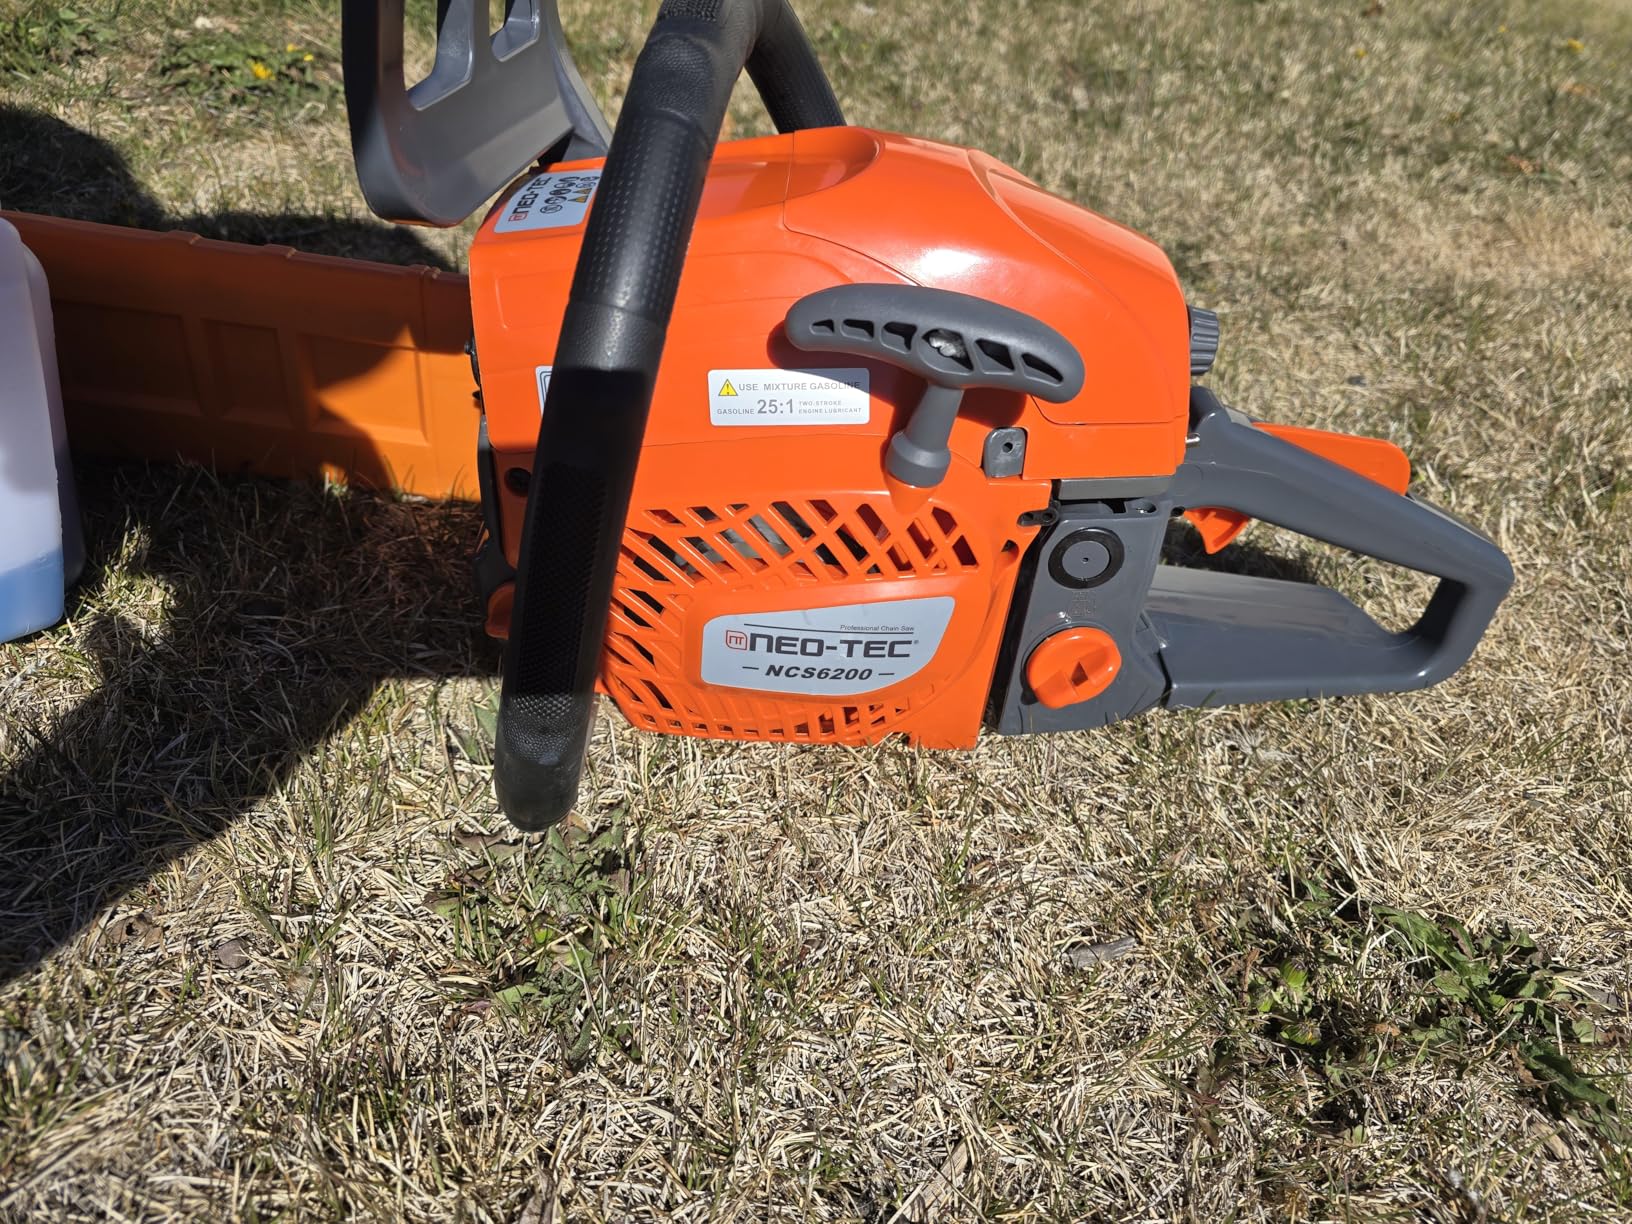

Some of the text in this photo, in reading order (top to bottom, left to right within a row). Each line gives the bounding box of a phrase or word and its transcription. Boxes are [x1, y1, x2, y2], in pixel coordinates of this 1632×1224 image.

[738, 381, 862, 391] USE MIXTURE GASOLINE
[757, 398, 793, 415] 25:1
[824, 407, 862, 415] LUBRICANT
[840, 624, 879, 632] Professional
[749, 632, 913, 658] NEO-TEC
[765, 664, 873, 681] NCS6200
